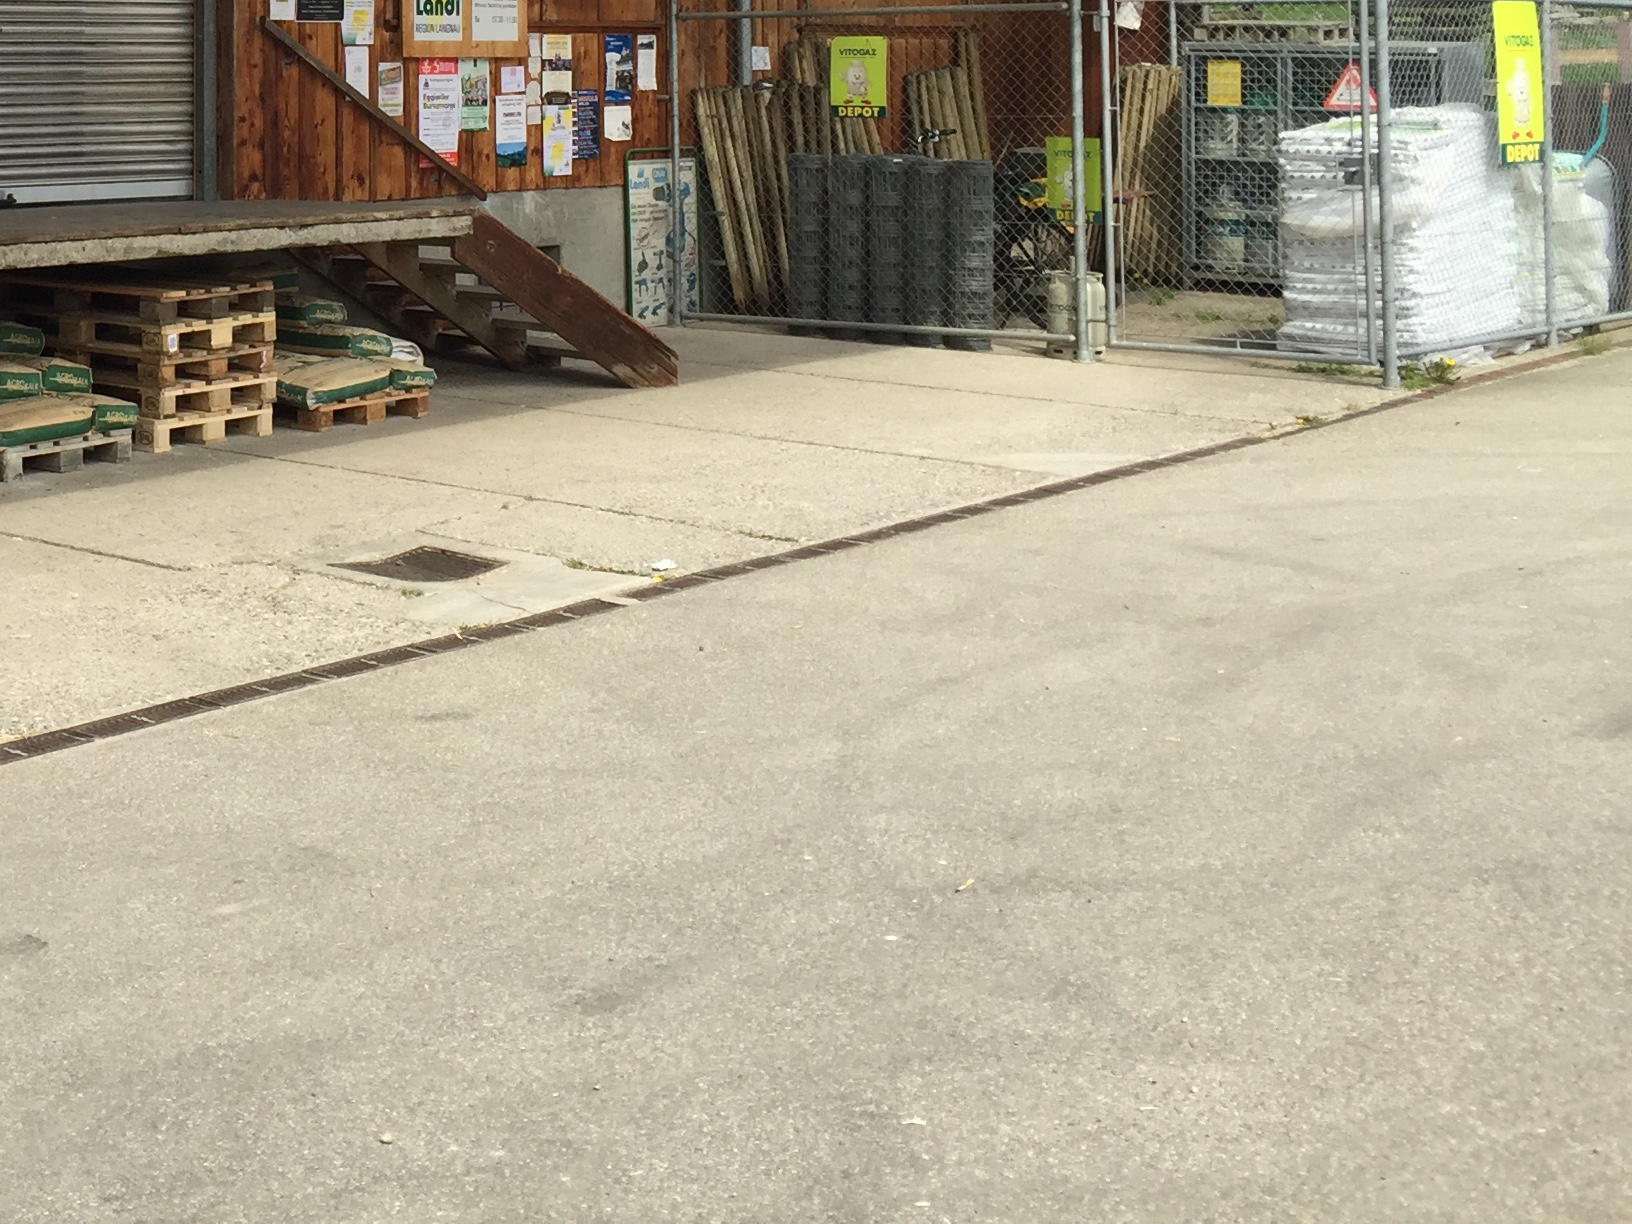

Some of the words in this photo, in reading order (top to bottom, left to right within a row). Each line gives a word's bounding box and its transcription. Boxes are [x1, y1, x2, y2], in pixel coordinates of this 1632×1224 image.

[1504, 34, 1534, 47] VITOGAZ
[839, 48, 877, 56] VITOGAZ
[838, 107, 880, 117] DEPOT
[1053, 150, 1092, 159] VITOZ
[1506, 143, 1540, 163] DEPOT
[1056, 209, 1095, 222] DET
